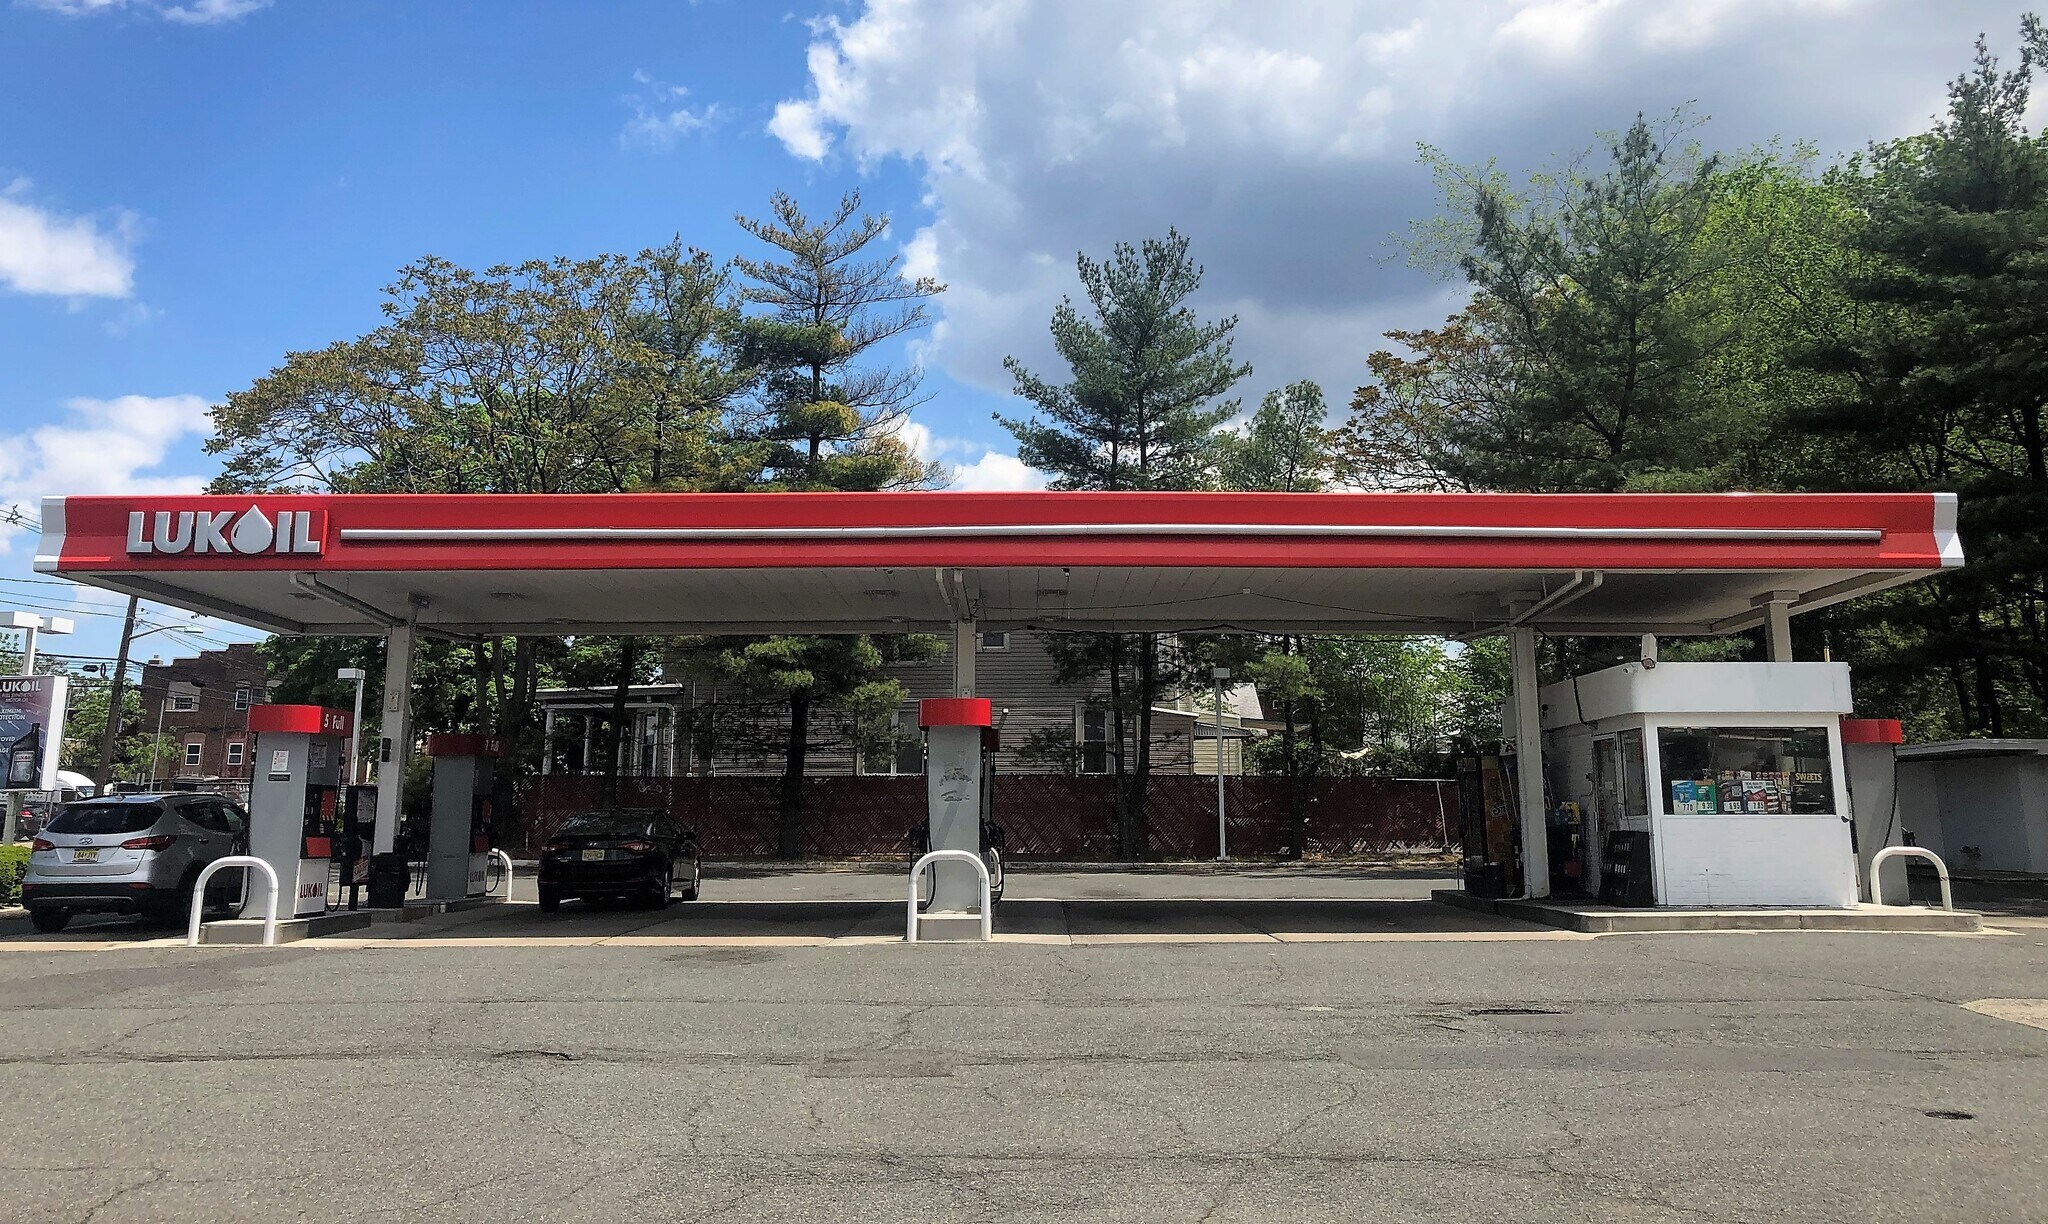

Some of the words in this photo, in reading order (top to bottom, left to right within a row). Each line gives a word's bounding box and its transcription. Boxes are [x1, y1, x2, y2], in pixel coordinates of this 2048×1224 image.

[126, 504, 321, 554] LUKOIL
[324, 713, 330, 728] 5
[332, 715, 345, 730] Full
[300, 883, 324, 899] LUKOIL
